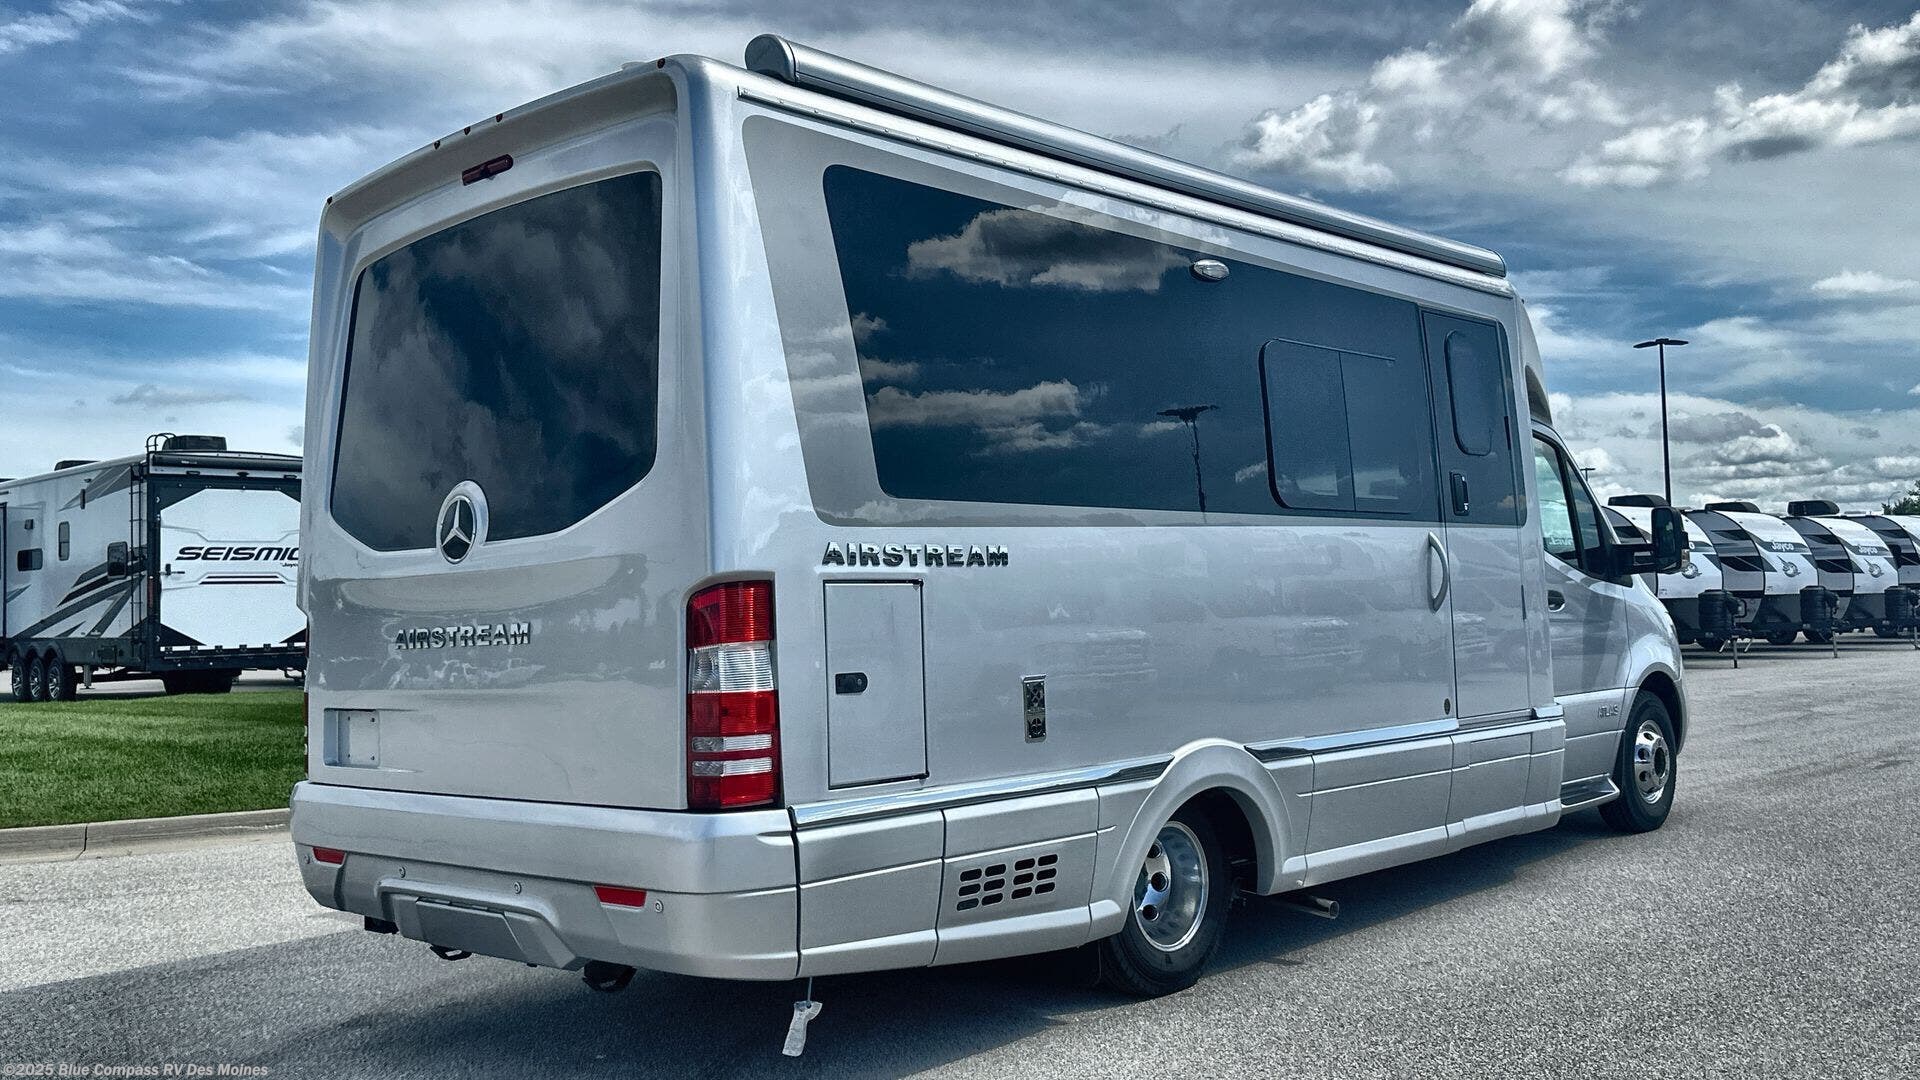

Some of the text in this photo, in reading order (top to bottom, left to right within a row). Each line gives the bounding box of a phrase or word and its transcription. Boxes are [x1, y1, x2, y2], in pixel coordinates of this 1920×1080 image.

[822, 541, 1009, 567] AIRSTREAM
[1770, 540, 1794, 552] Jayco
[395, 622, 531, 650] AIRSTREAM
